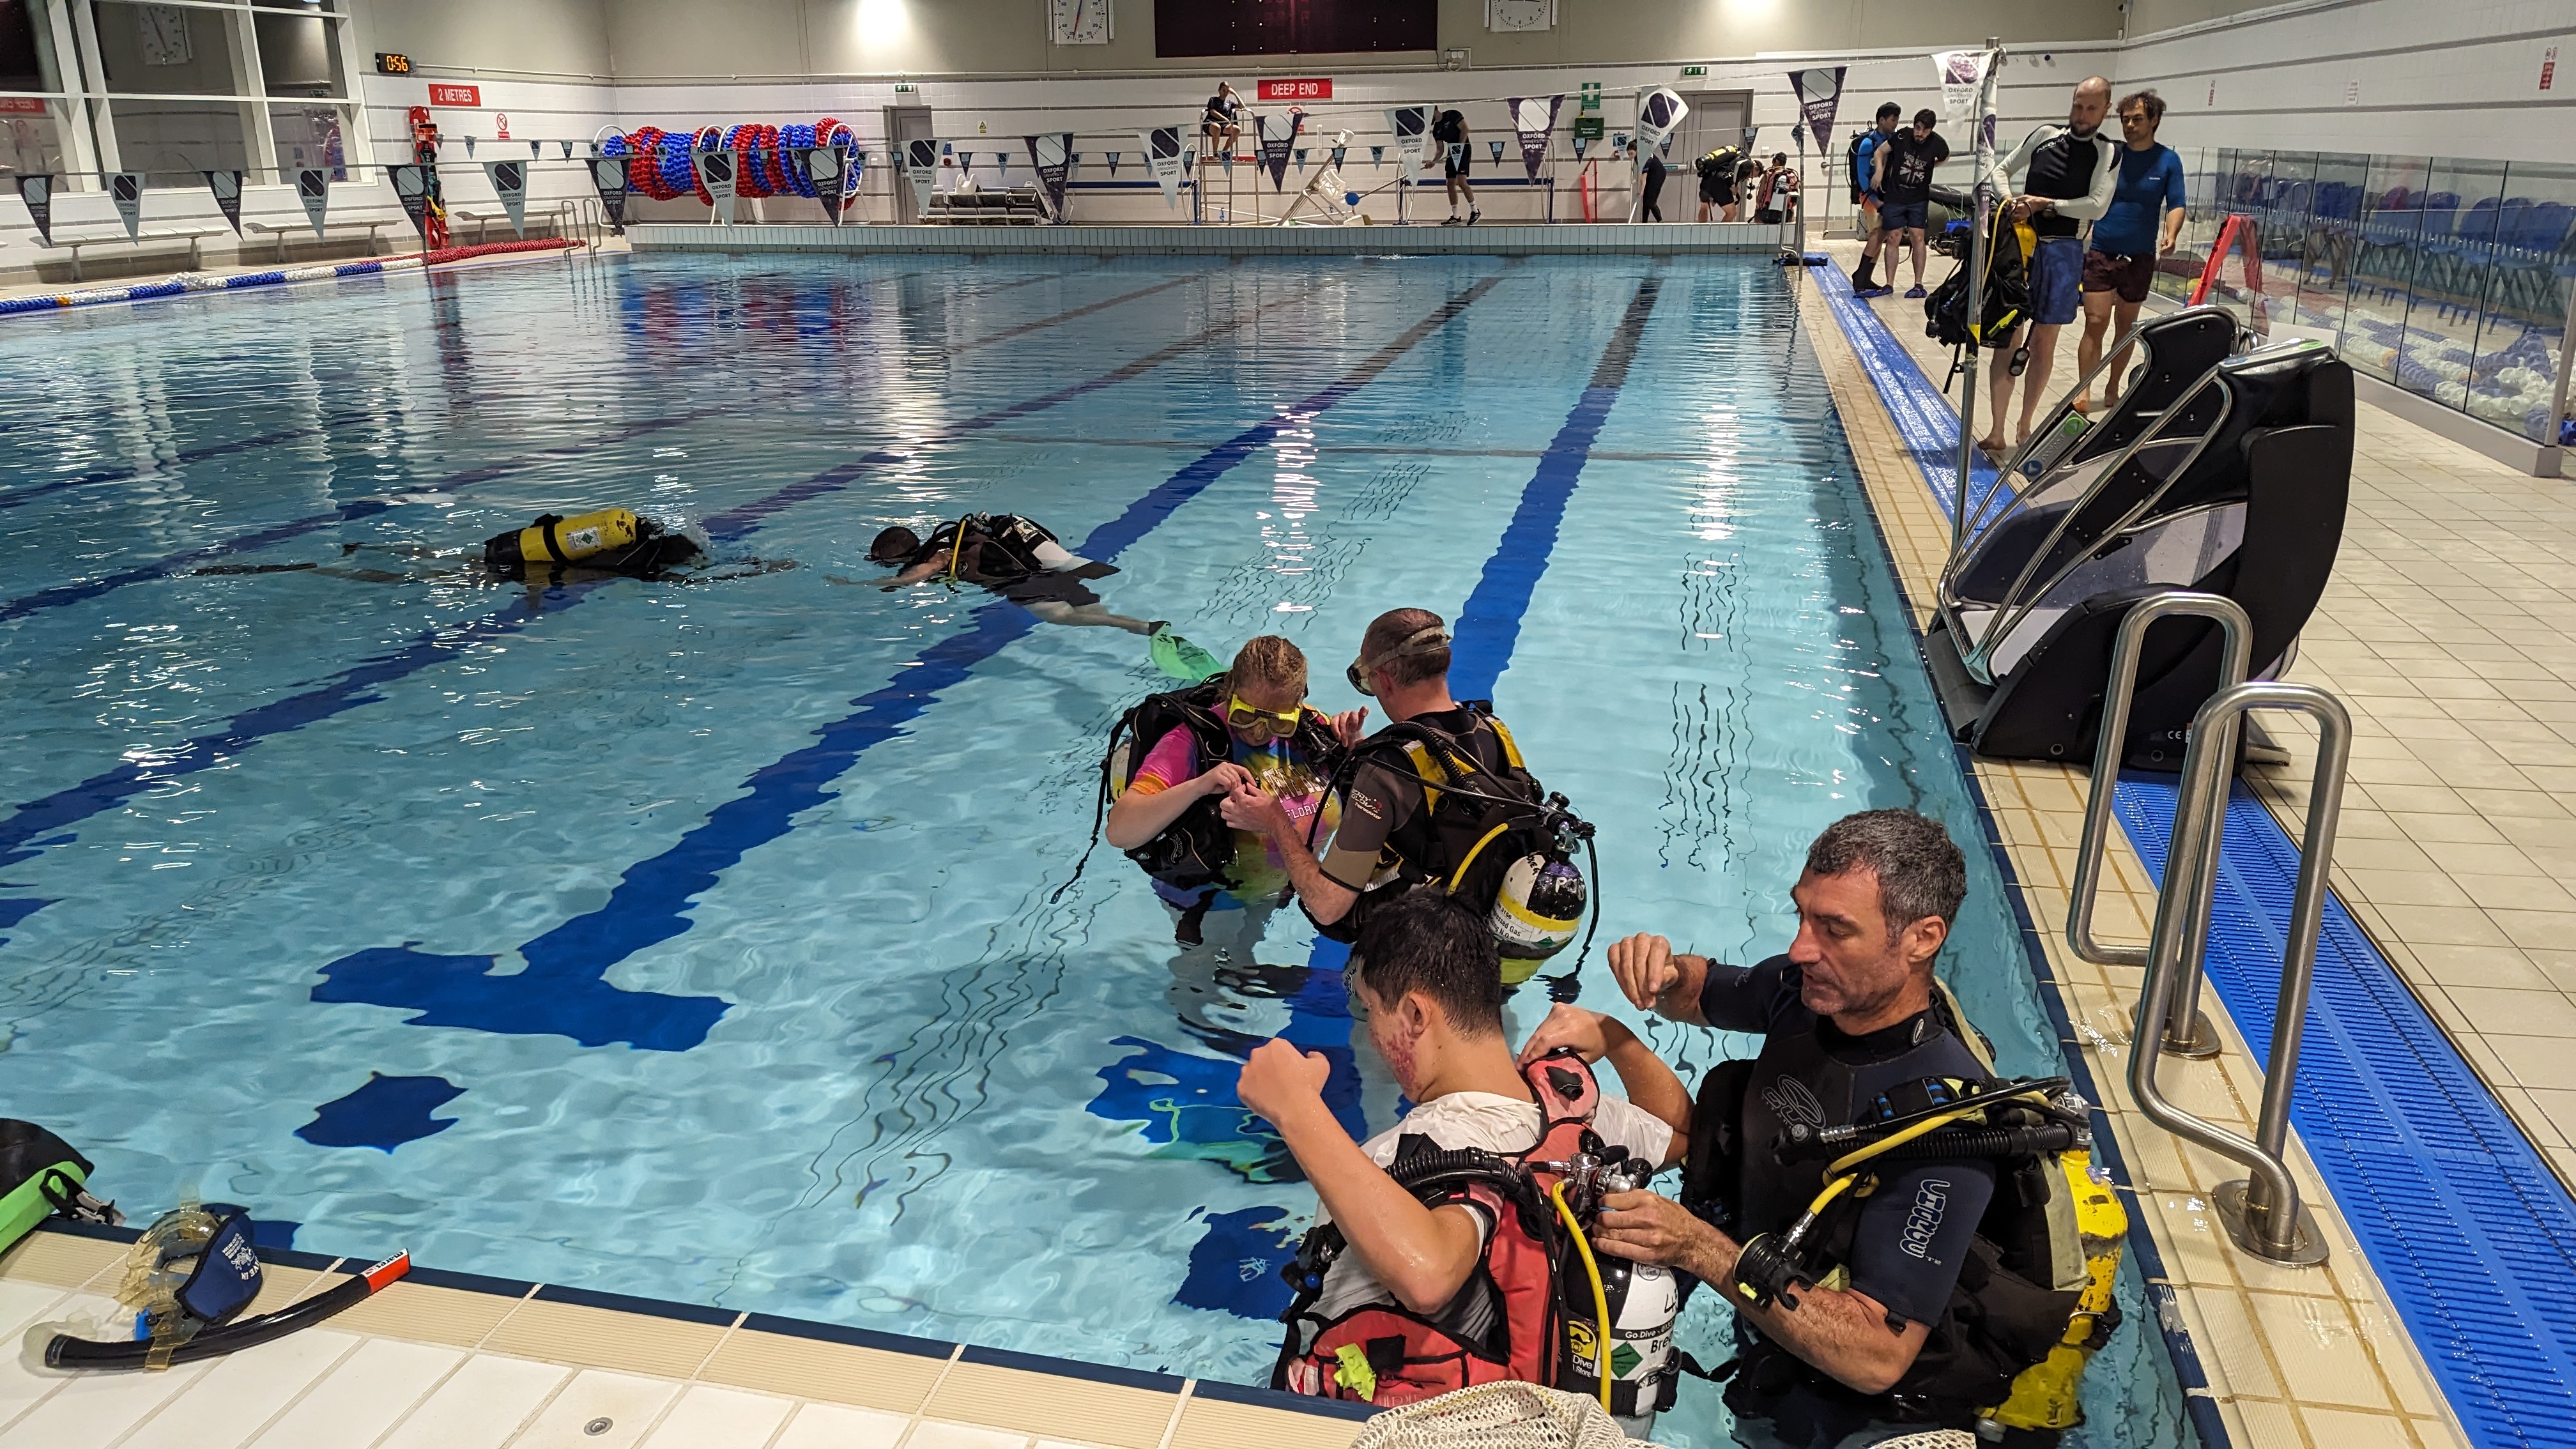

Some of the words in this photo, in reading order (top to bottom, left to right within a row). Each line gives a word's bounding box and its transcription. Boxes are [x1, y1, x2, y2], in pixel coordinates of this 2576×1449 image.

[387, 56, 408, 72] 0:56
[438, 88, 443, 101] 2
[445, 88, 473, 102] METRES
[1271, 83, 1296, 96] DEEP
[1299, 82, 1319, 95] END
[1809, 101, 1834, 111] OXFORD
[1812, 112, 1832, 121] SPORT
[1641, 125, 1660, 137] OXFORD
[1640, 136, 1654, 146] SPORT
[1509, 925, 1521, 937] Gas
[376, 1252, 404, 1269] mares
[241, 1272, 249, 1280] IN
[1573, 1356, 1593, 1370] Dive
[1575, 1367, 1591, 1377] Store
